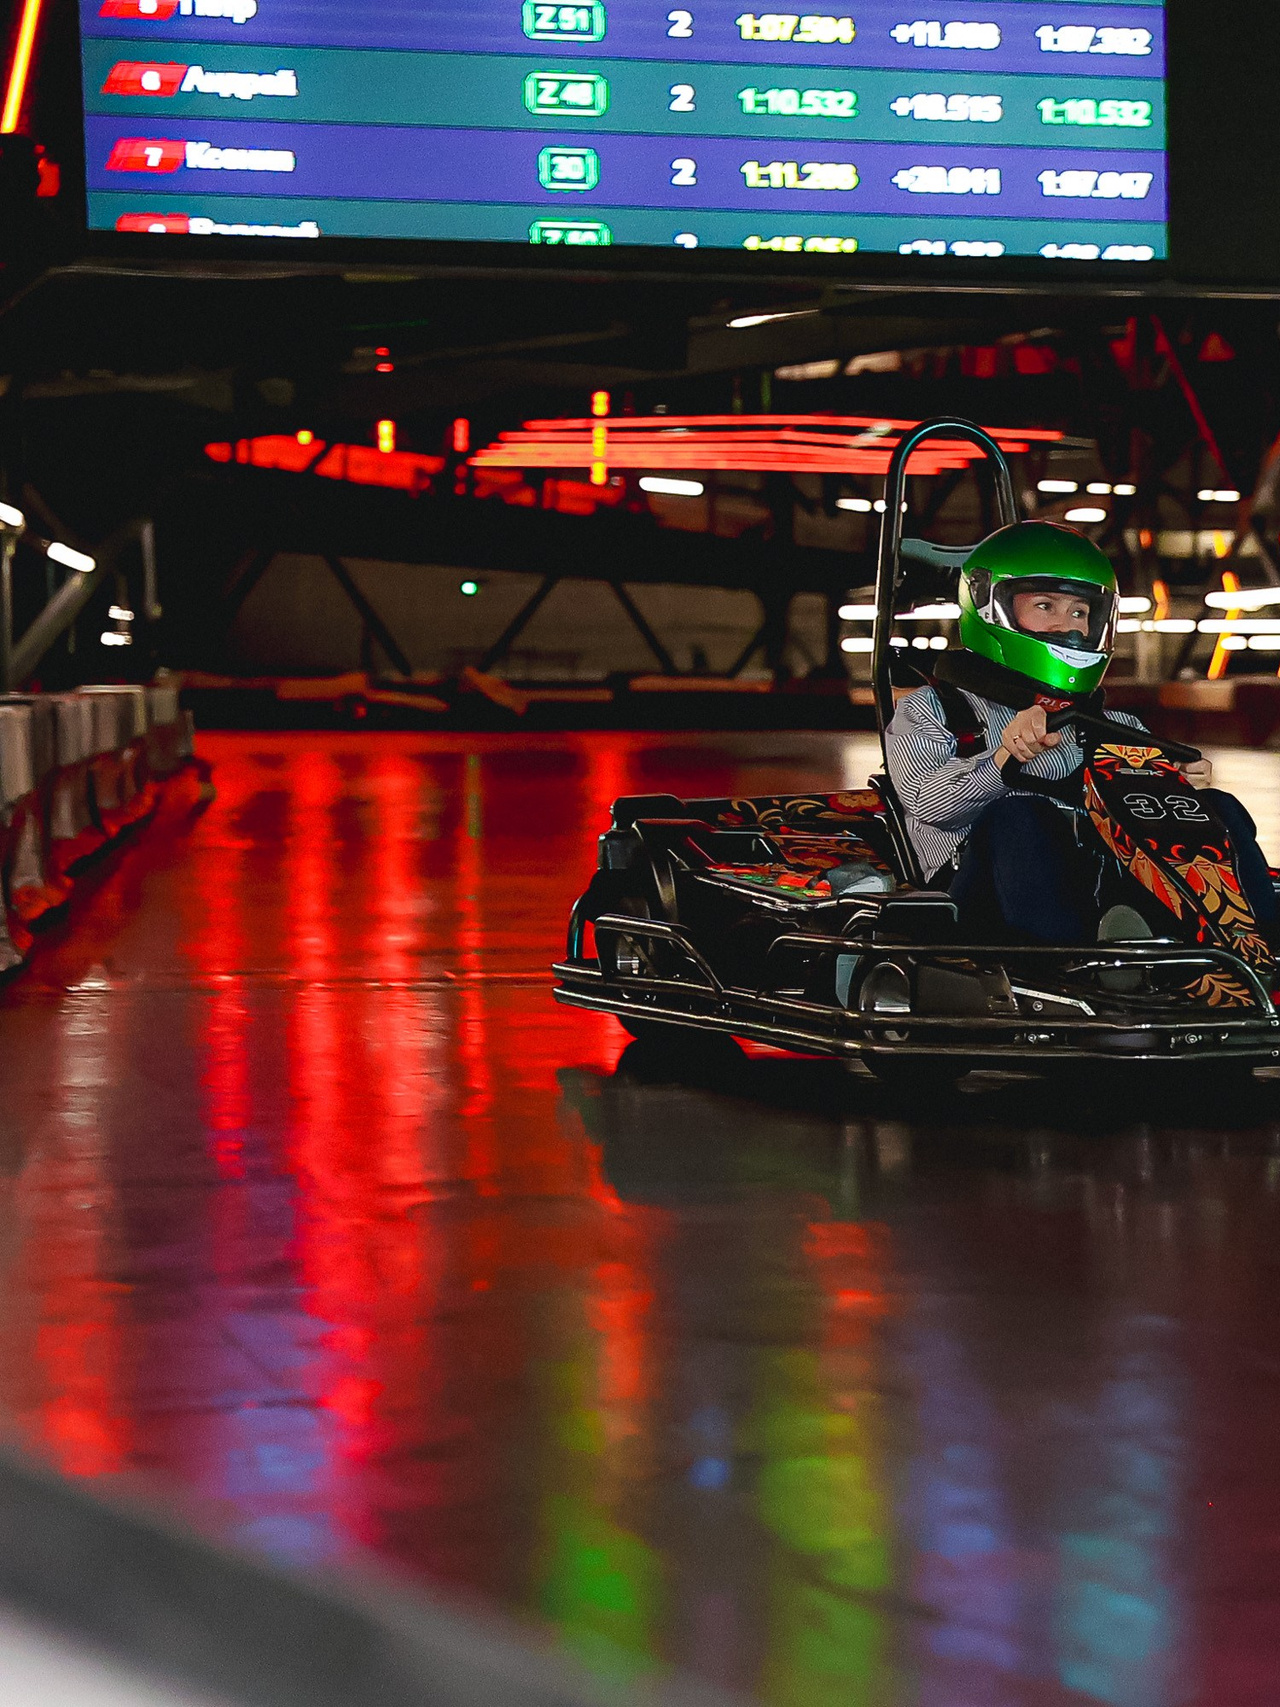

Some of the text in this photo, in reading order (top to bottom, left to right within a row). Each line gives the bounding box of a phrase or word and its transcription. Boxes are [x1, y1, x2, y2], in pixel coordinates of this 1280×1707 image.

[668, 11, 692, 37] 2
[670, 85, 694, 111] 2
[145, 147, 163, 166] 7
[672, 159, 696, 185] 2
[1123, 793, 1209, 821] 32
